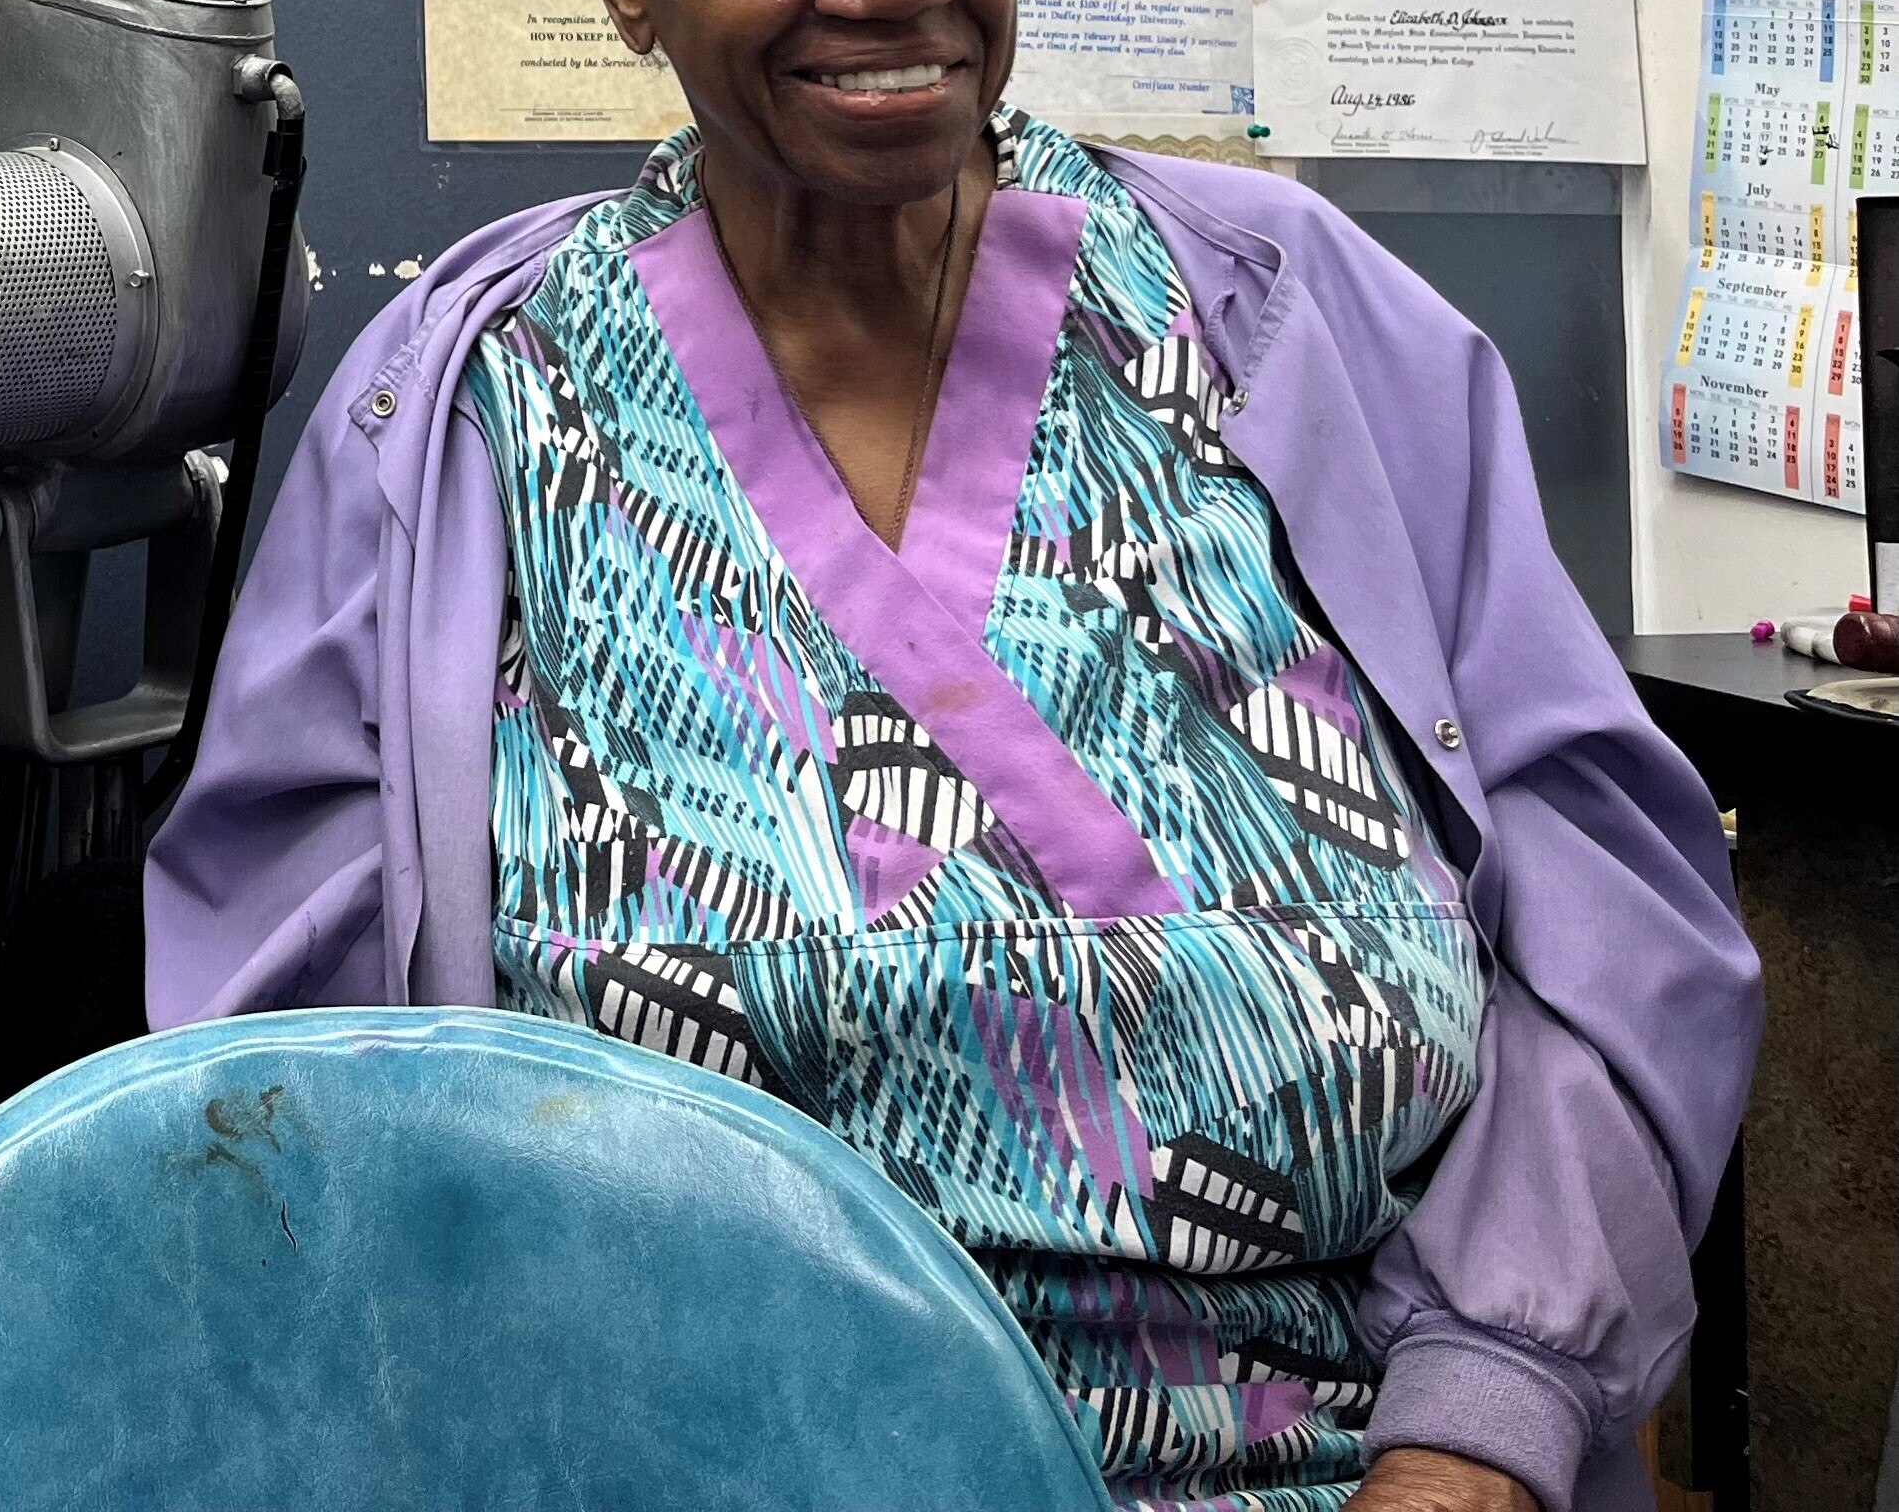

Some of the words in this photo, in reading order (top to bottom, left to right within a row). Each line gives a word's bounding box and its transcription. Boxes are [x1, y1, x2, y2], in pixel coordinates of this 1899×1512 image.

[1754, 83, 1781, 97] May
[1746, 183, 1772, 197] July
[1717, 278, 1787, 300] September
[1700, 375, 1768, 399] November
